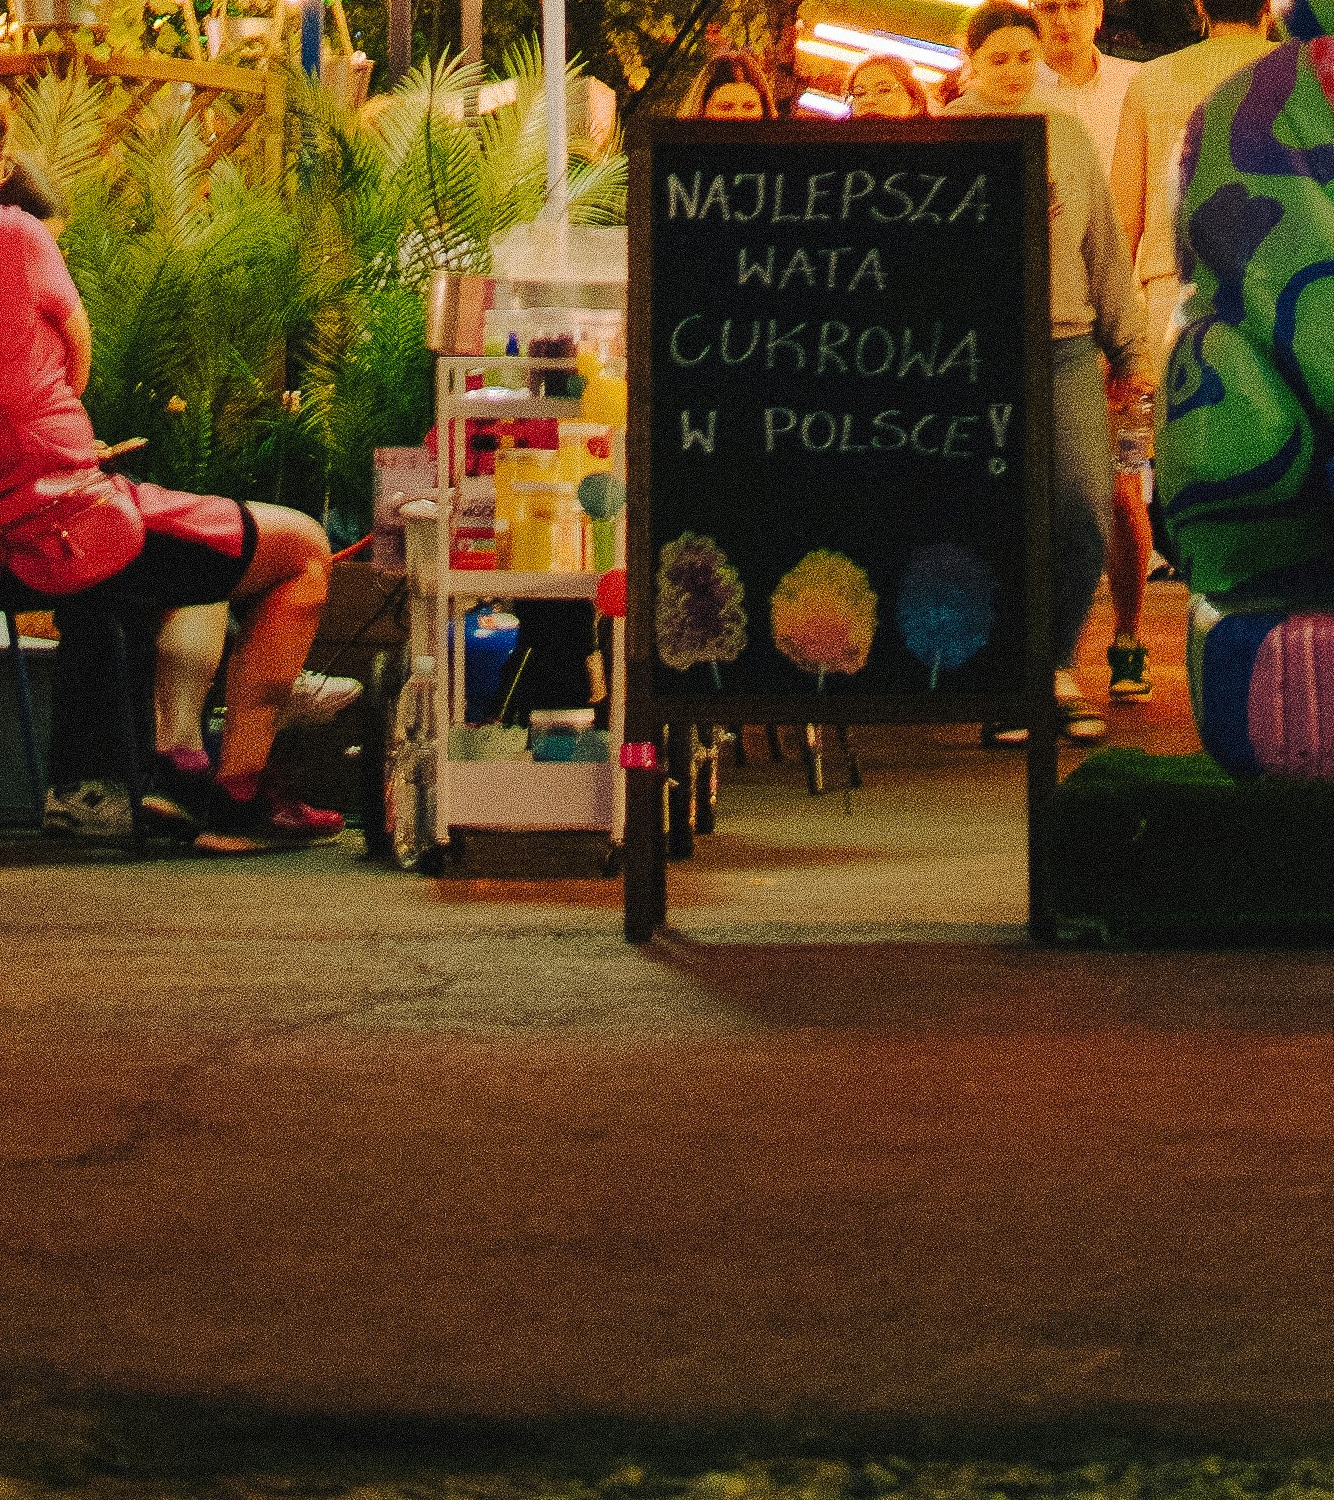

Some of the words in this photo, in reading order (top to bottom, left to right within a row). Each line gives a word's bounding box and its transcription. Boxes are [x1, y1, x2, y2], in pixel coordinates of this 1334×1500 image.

[667, 170, 990, 224] NAJLEPSZA
[738, 246, 889, 292] WATA
[670, 314, 983, 383] CUKROWA
[680, 409, 717, 453] W
[764, 403, 1013, 475] POLSCE!
